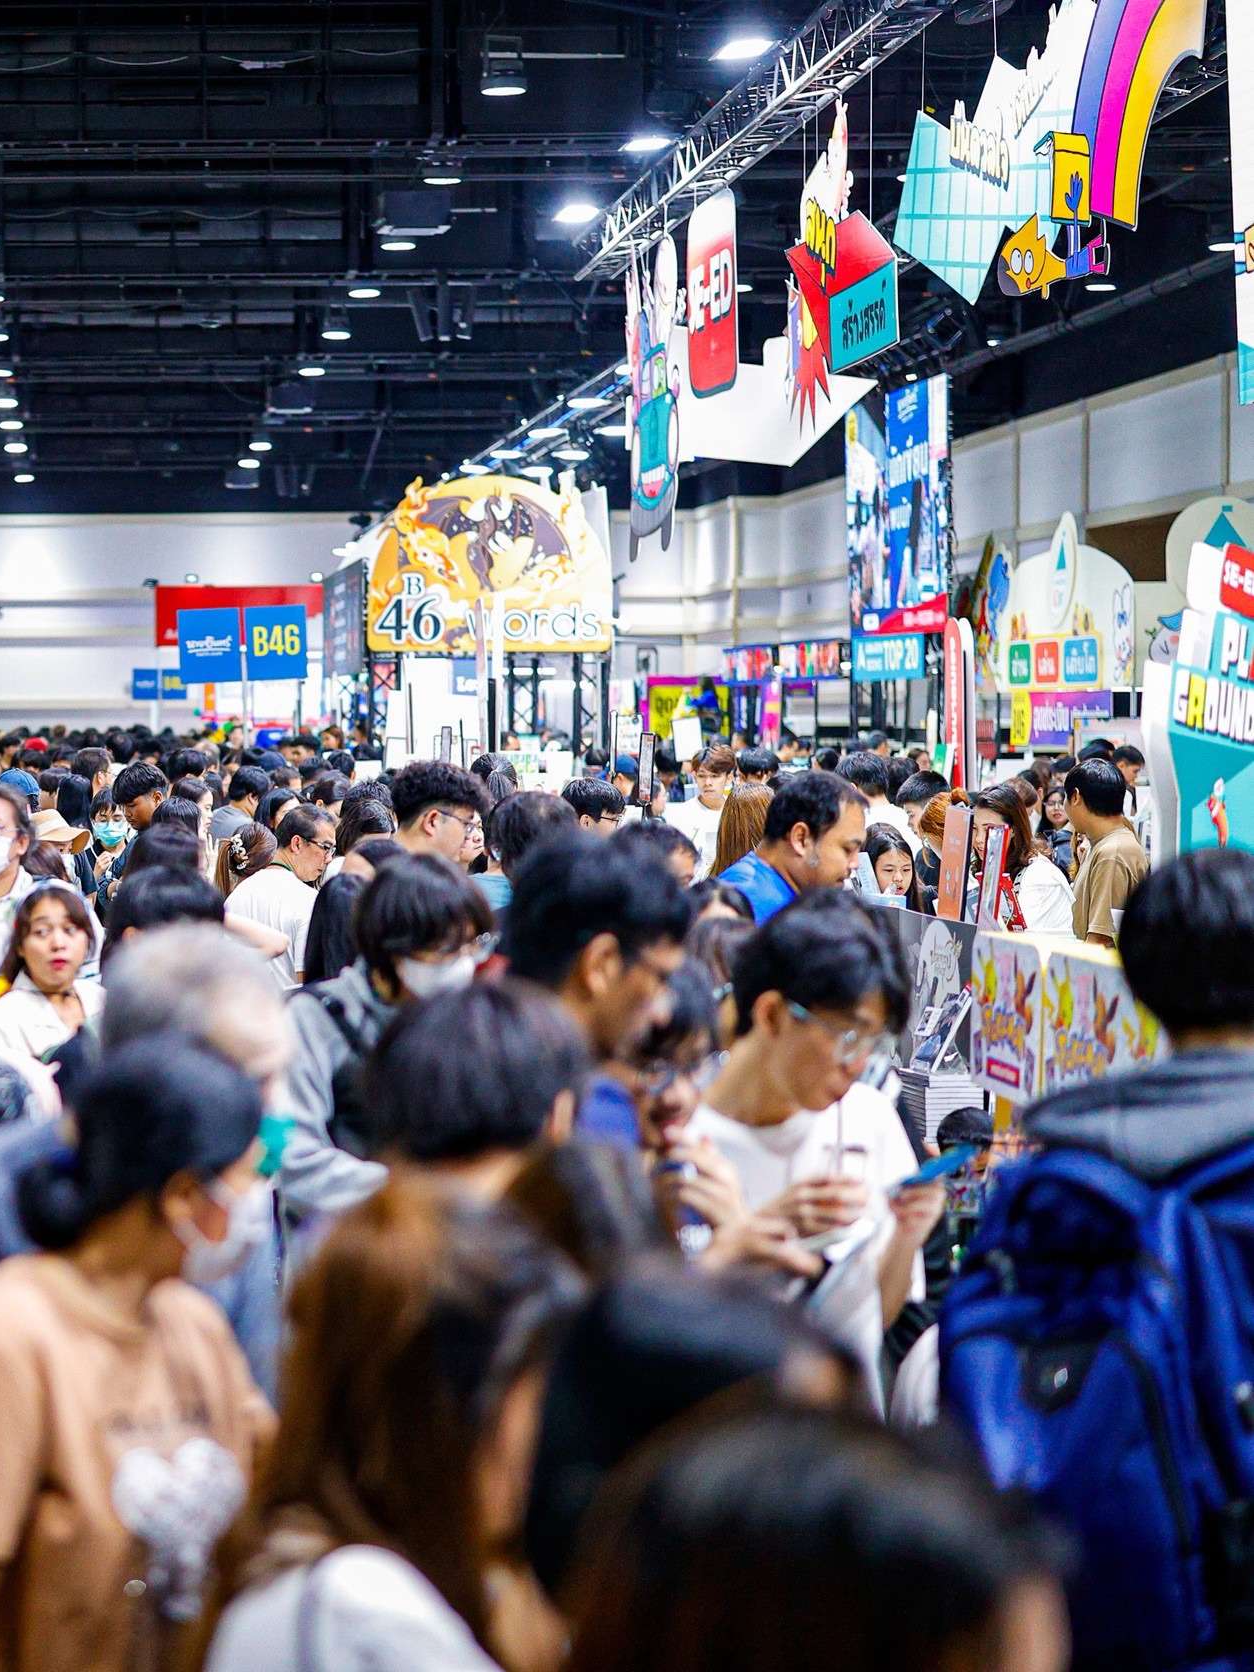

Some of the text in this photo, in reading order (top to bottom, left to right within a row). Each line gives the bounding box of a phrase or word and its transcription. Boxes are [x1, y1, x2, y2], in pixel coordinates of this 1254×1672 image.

[841, 279, 887, 350] สร้างสรรค์
[405, 575, 423, 596] B
[377, 598, 443, 642] 46
[252, 624, 301, 657] B46
